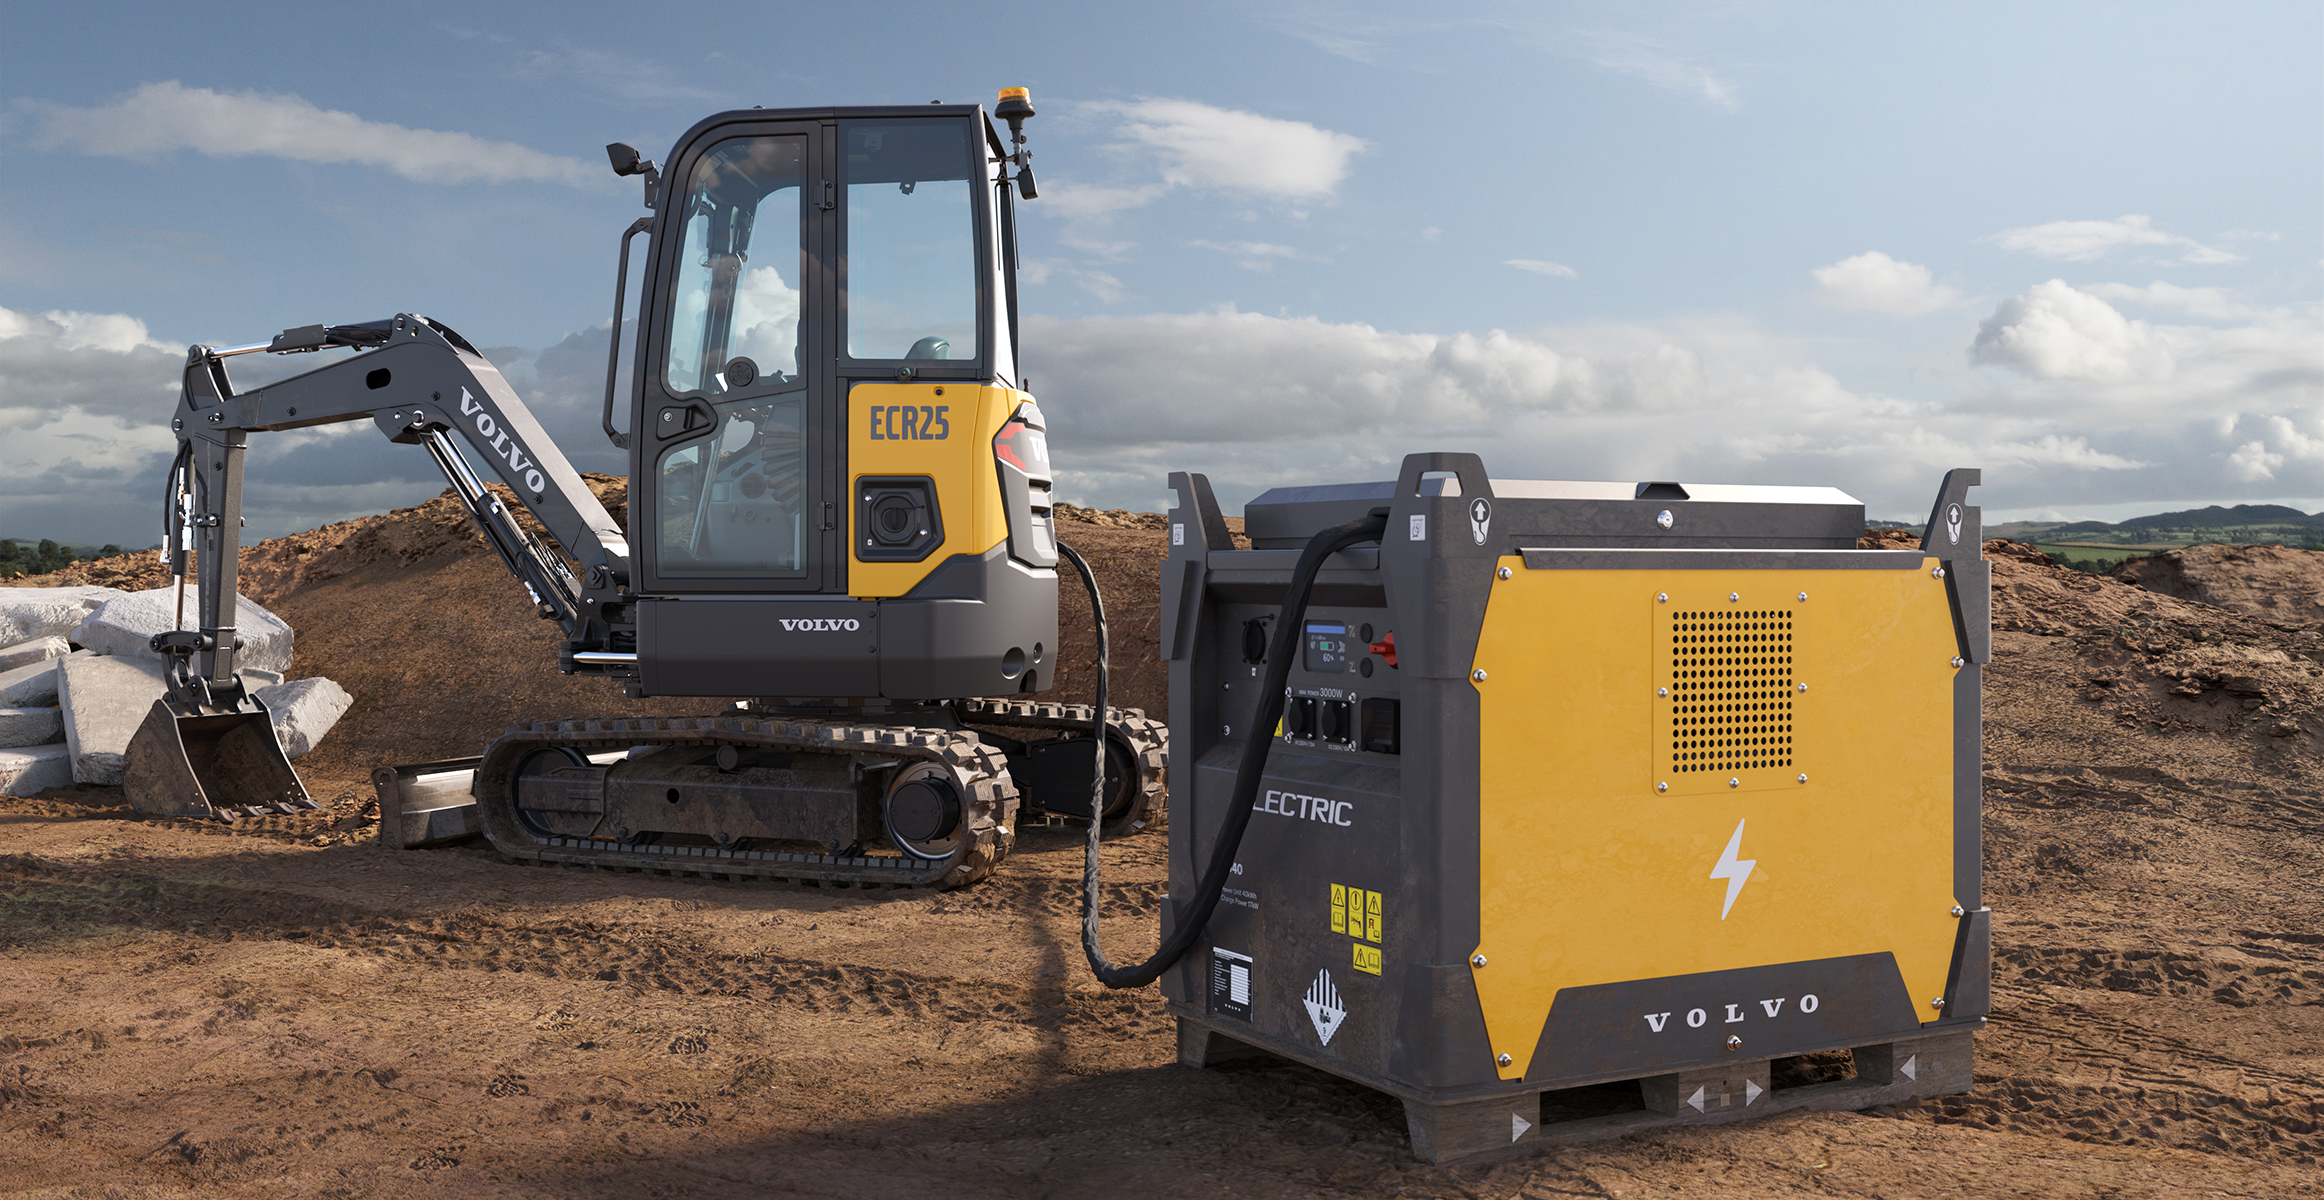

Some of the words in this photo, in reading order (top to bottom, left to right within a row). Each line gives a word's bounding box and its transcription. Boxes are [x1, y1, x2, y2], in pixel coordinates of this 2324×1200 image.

[870, 405, 949, 440] ECR25
[460, 385, 545, 493] VOLVO
[779, 619, 860, 632] VOLVO
[1320, 687, 1343, 698] 3000W
[1230, 862, 1243, 875] 40
[1644, 993, 1819, 1033] VOLVO
